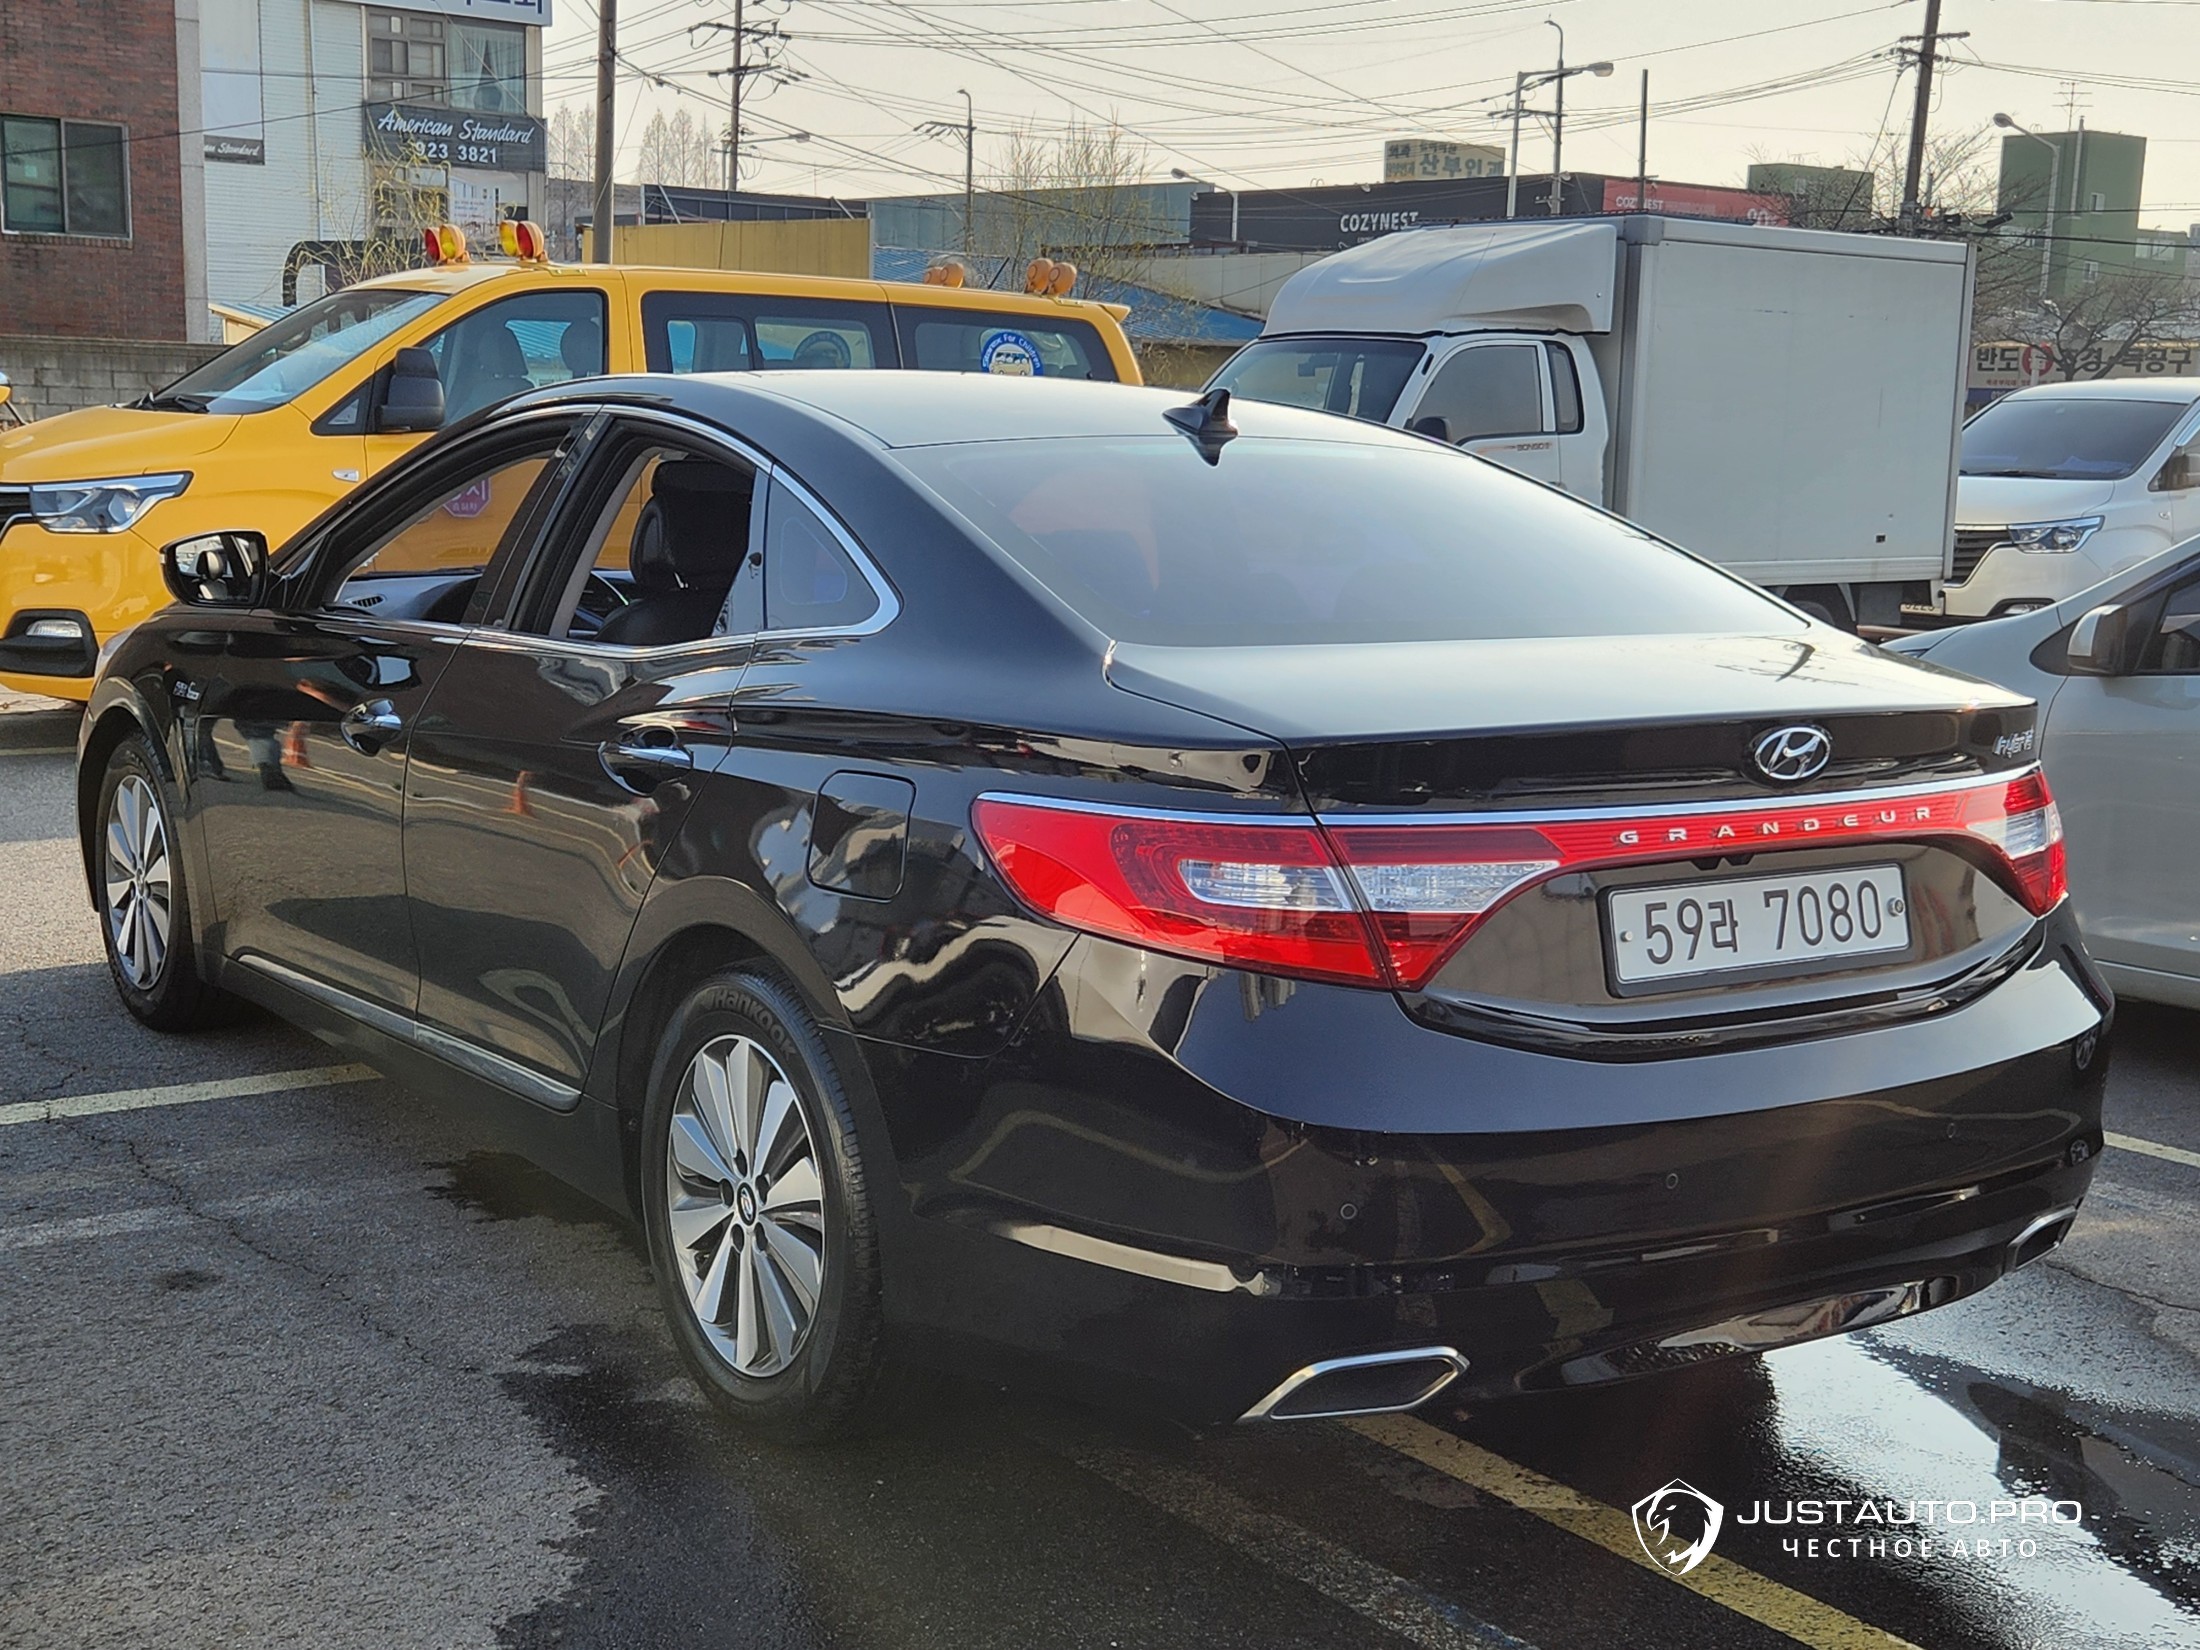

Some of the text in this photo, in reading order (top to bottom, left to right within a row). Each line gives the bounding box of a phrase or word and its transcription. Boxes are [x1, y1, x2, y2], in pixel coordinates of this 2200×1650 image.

[377, 109, 535, 145] American Standard
[416, 141, 498, 164] 923 3821
[1615, 196, 1664, 210] COZEST
[1340, 211, 1419, 232] COZYNEST
[1003, 333, 1016, 343] For
[1018, 338, 1041, 369] Children
[1976, 347, 2019, 373] 반도
[1617, 806, 1931, 845] GRANDEUR
[1645, 879, 1883, 965] 59라 7080
